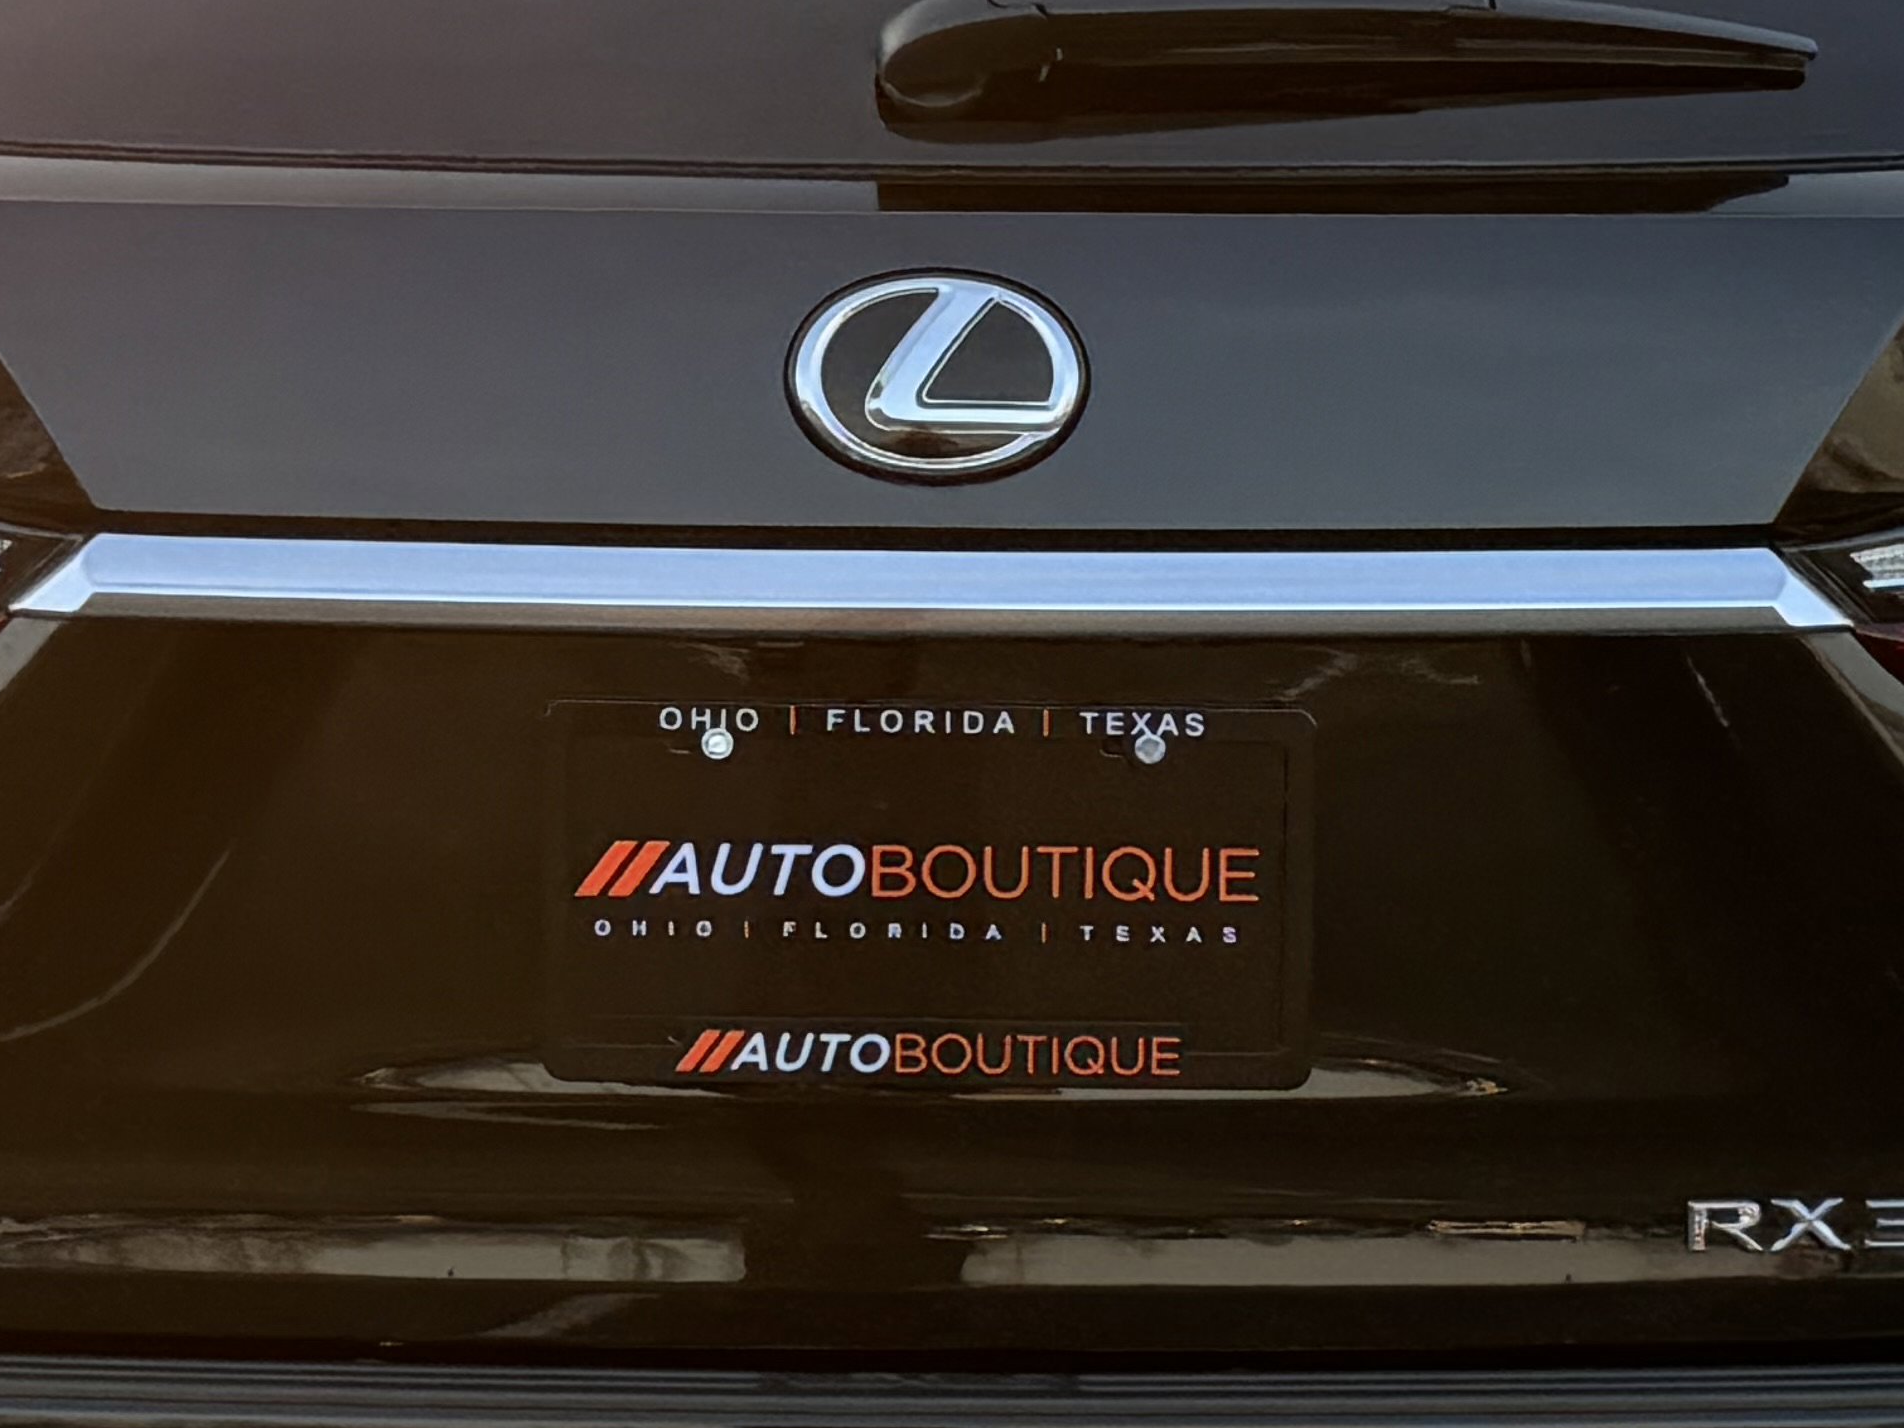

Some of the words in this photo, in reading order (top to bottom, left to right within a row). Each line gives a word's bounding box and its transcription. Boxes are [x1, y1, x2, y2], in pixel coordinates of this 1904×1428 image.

[658, 706, 760, 733] OHIO
[826, 708, 1016, 735] FLORIDA
[1079, 711, 1205, 737] TEXAS
[648, 841, 1261, 903] AUTOBOUTIQUE
[594, 919, 713, 937] OHIO
[782, 920, 1003, 940] FLORIDA
[1079, 924, 1238, 944] TEXAS
[730, 1031, 1182, 1077] AUTOBOUTIQUE
